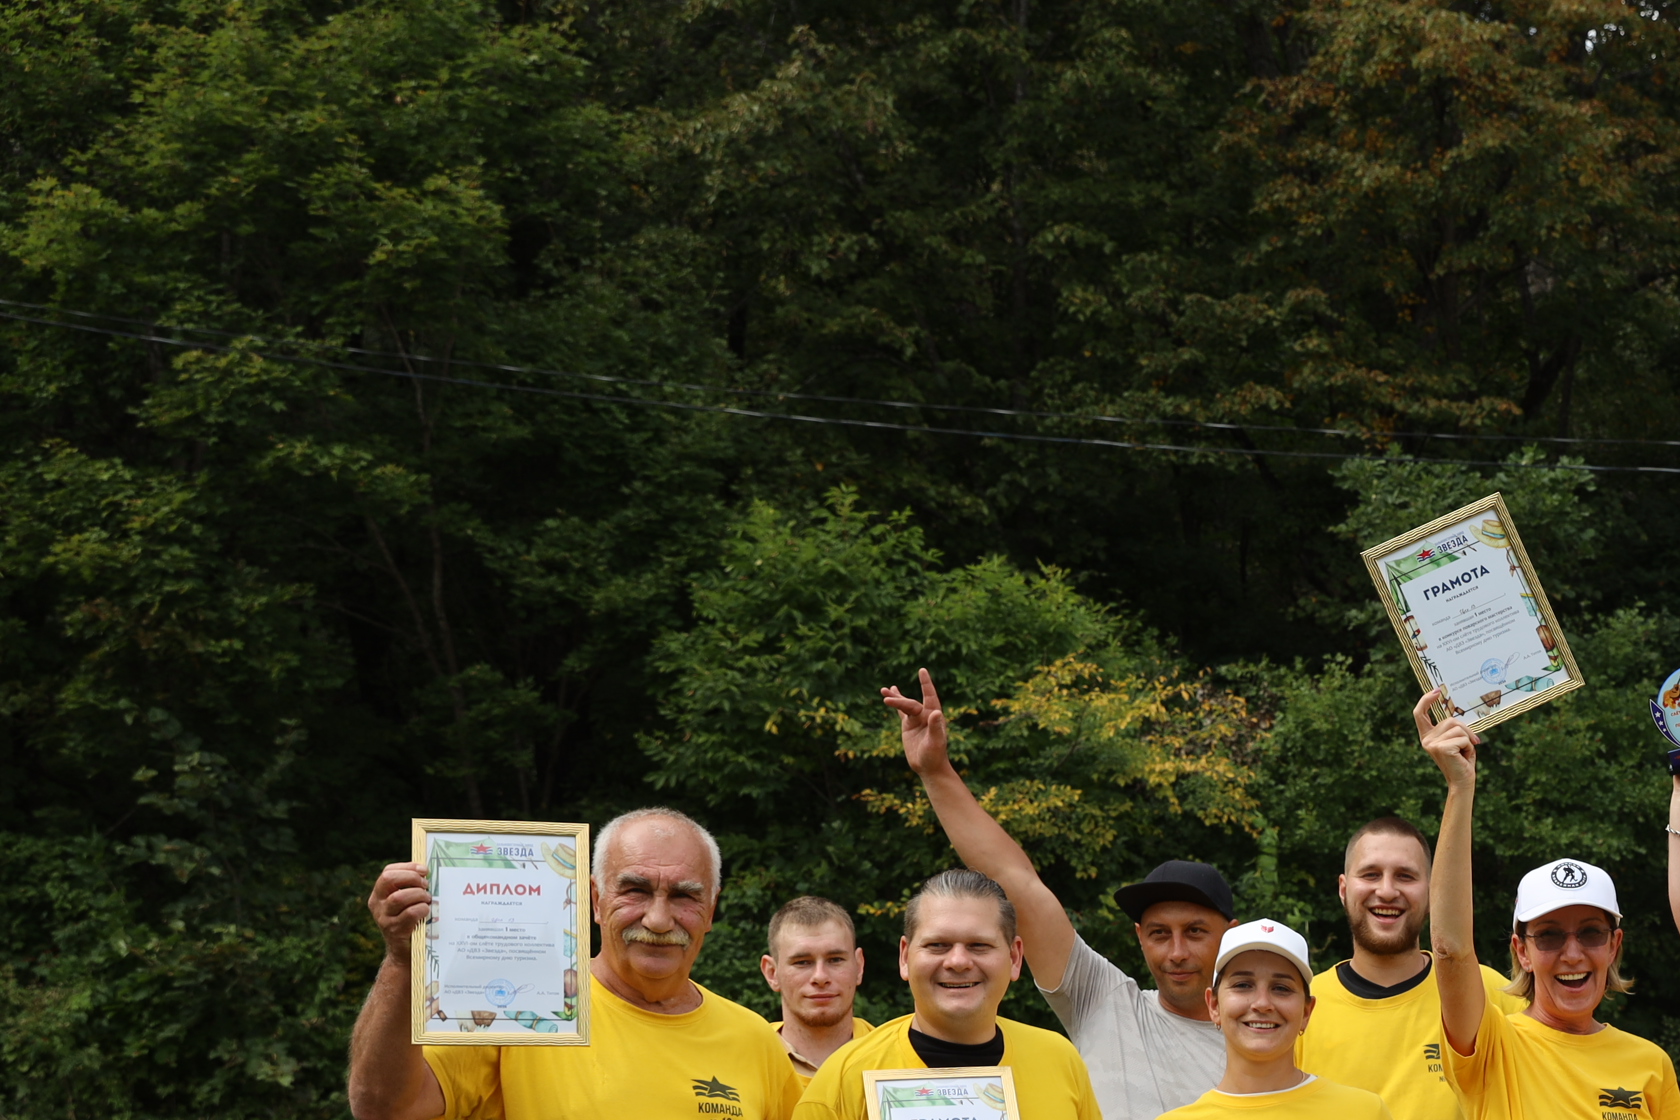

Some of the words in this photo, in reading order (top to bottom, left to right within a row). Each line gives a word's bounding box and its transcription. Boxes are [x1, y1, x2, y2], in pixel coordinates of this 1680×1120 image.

[1436, 534, 1469, 555] ЗВЕЗДА
[1422, 563, 1491, 601] ГРАМОТА
[1445, 585, 1479, 603] НАГРАЖДАЕТСЯ
[497, 847, 534, 857] ЗВЕЗДА
[463, 882, 541, 897] ДИПЛОМ
[937, 1087, 969, 1096] ЗВЕЗДА
[698, 1102, 743, 1117] КОМАНДА
